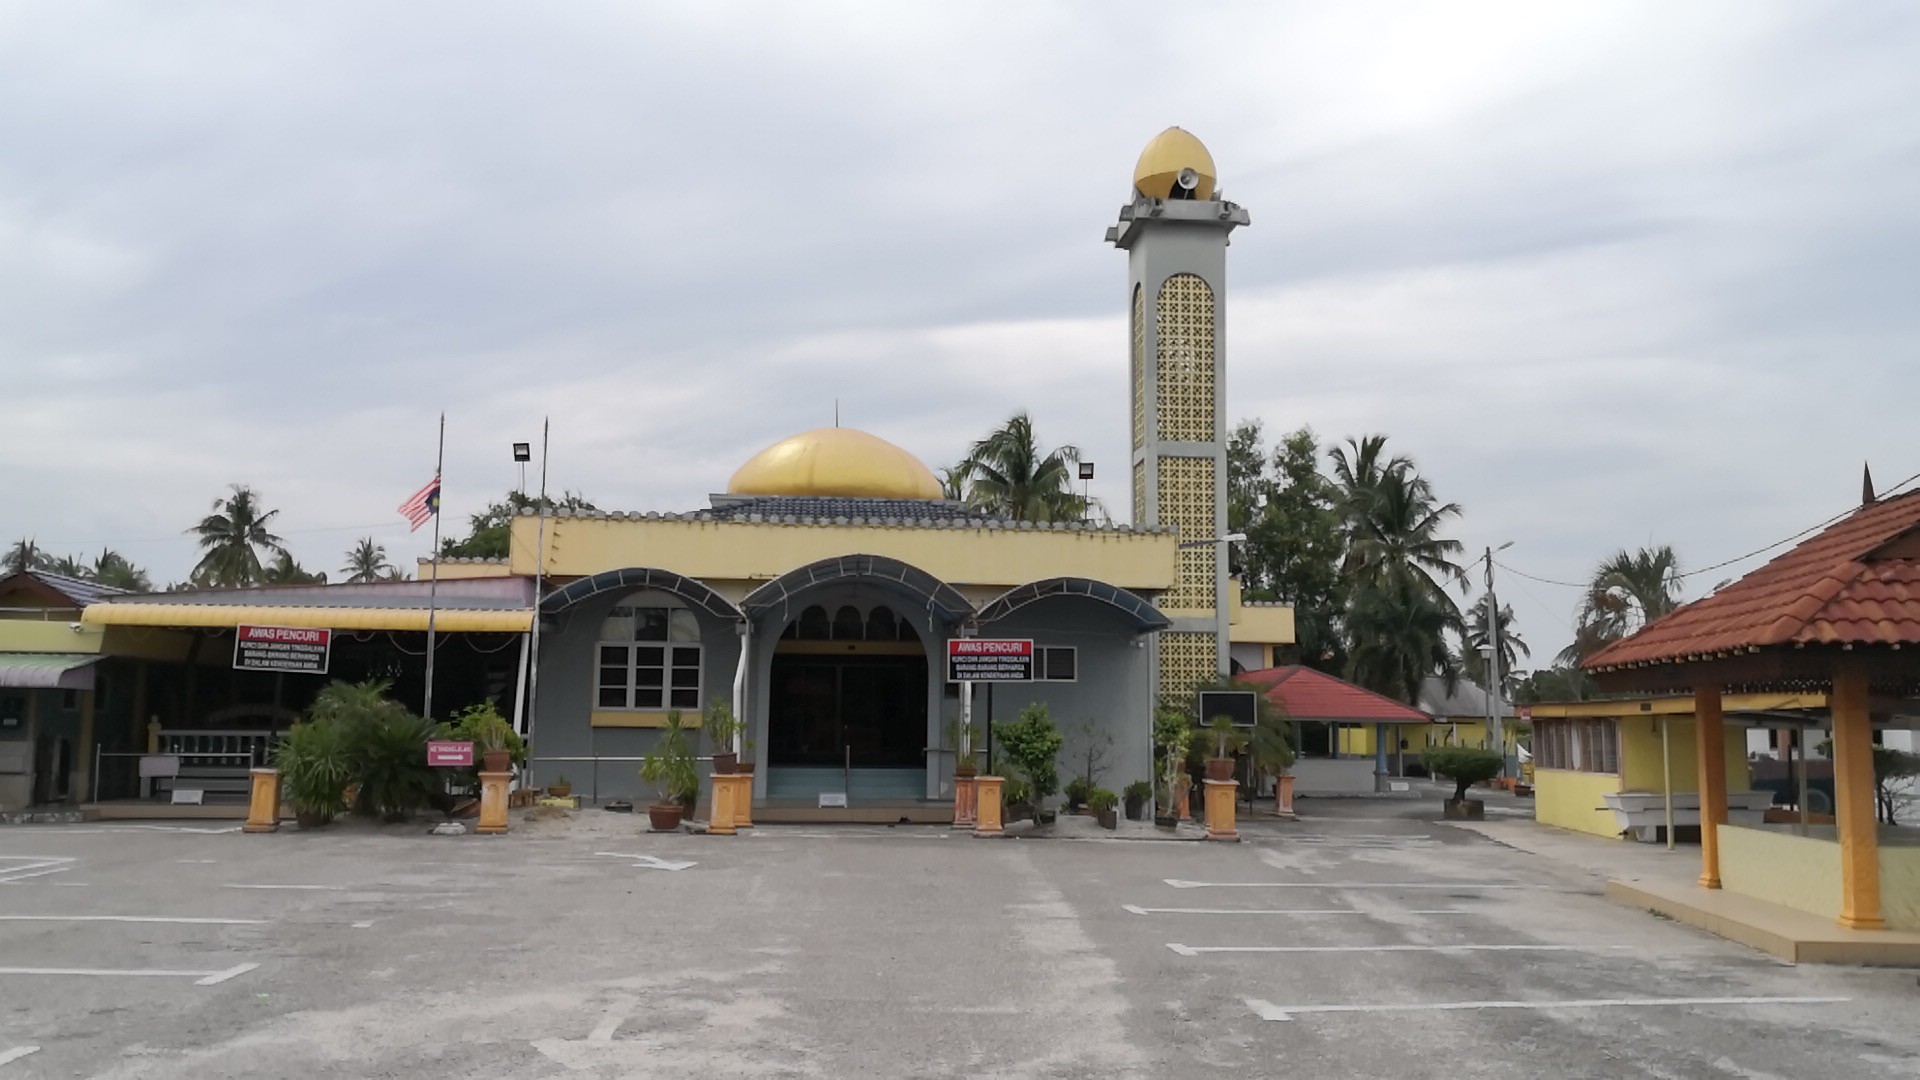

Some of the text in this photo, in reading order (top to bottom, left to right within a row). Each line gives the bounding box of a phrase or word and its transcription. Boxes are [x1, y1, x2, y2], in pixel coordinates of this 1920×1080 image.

[248, 628, 319, 641] AWAS PENCURI
[957, 642, 1023, 652] AWAS PENCURI
[244, 658, 251, 666] DI
[251, 659, 269, 667] DALAM
